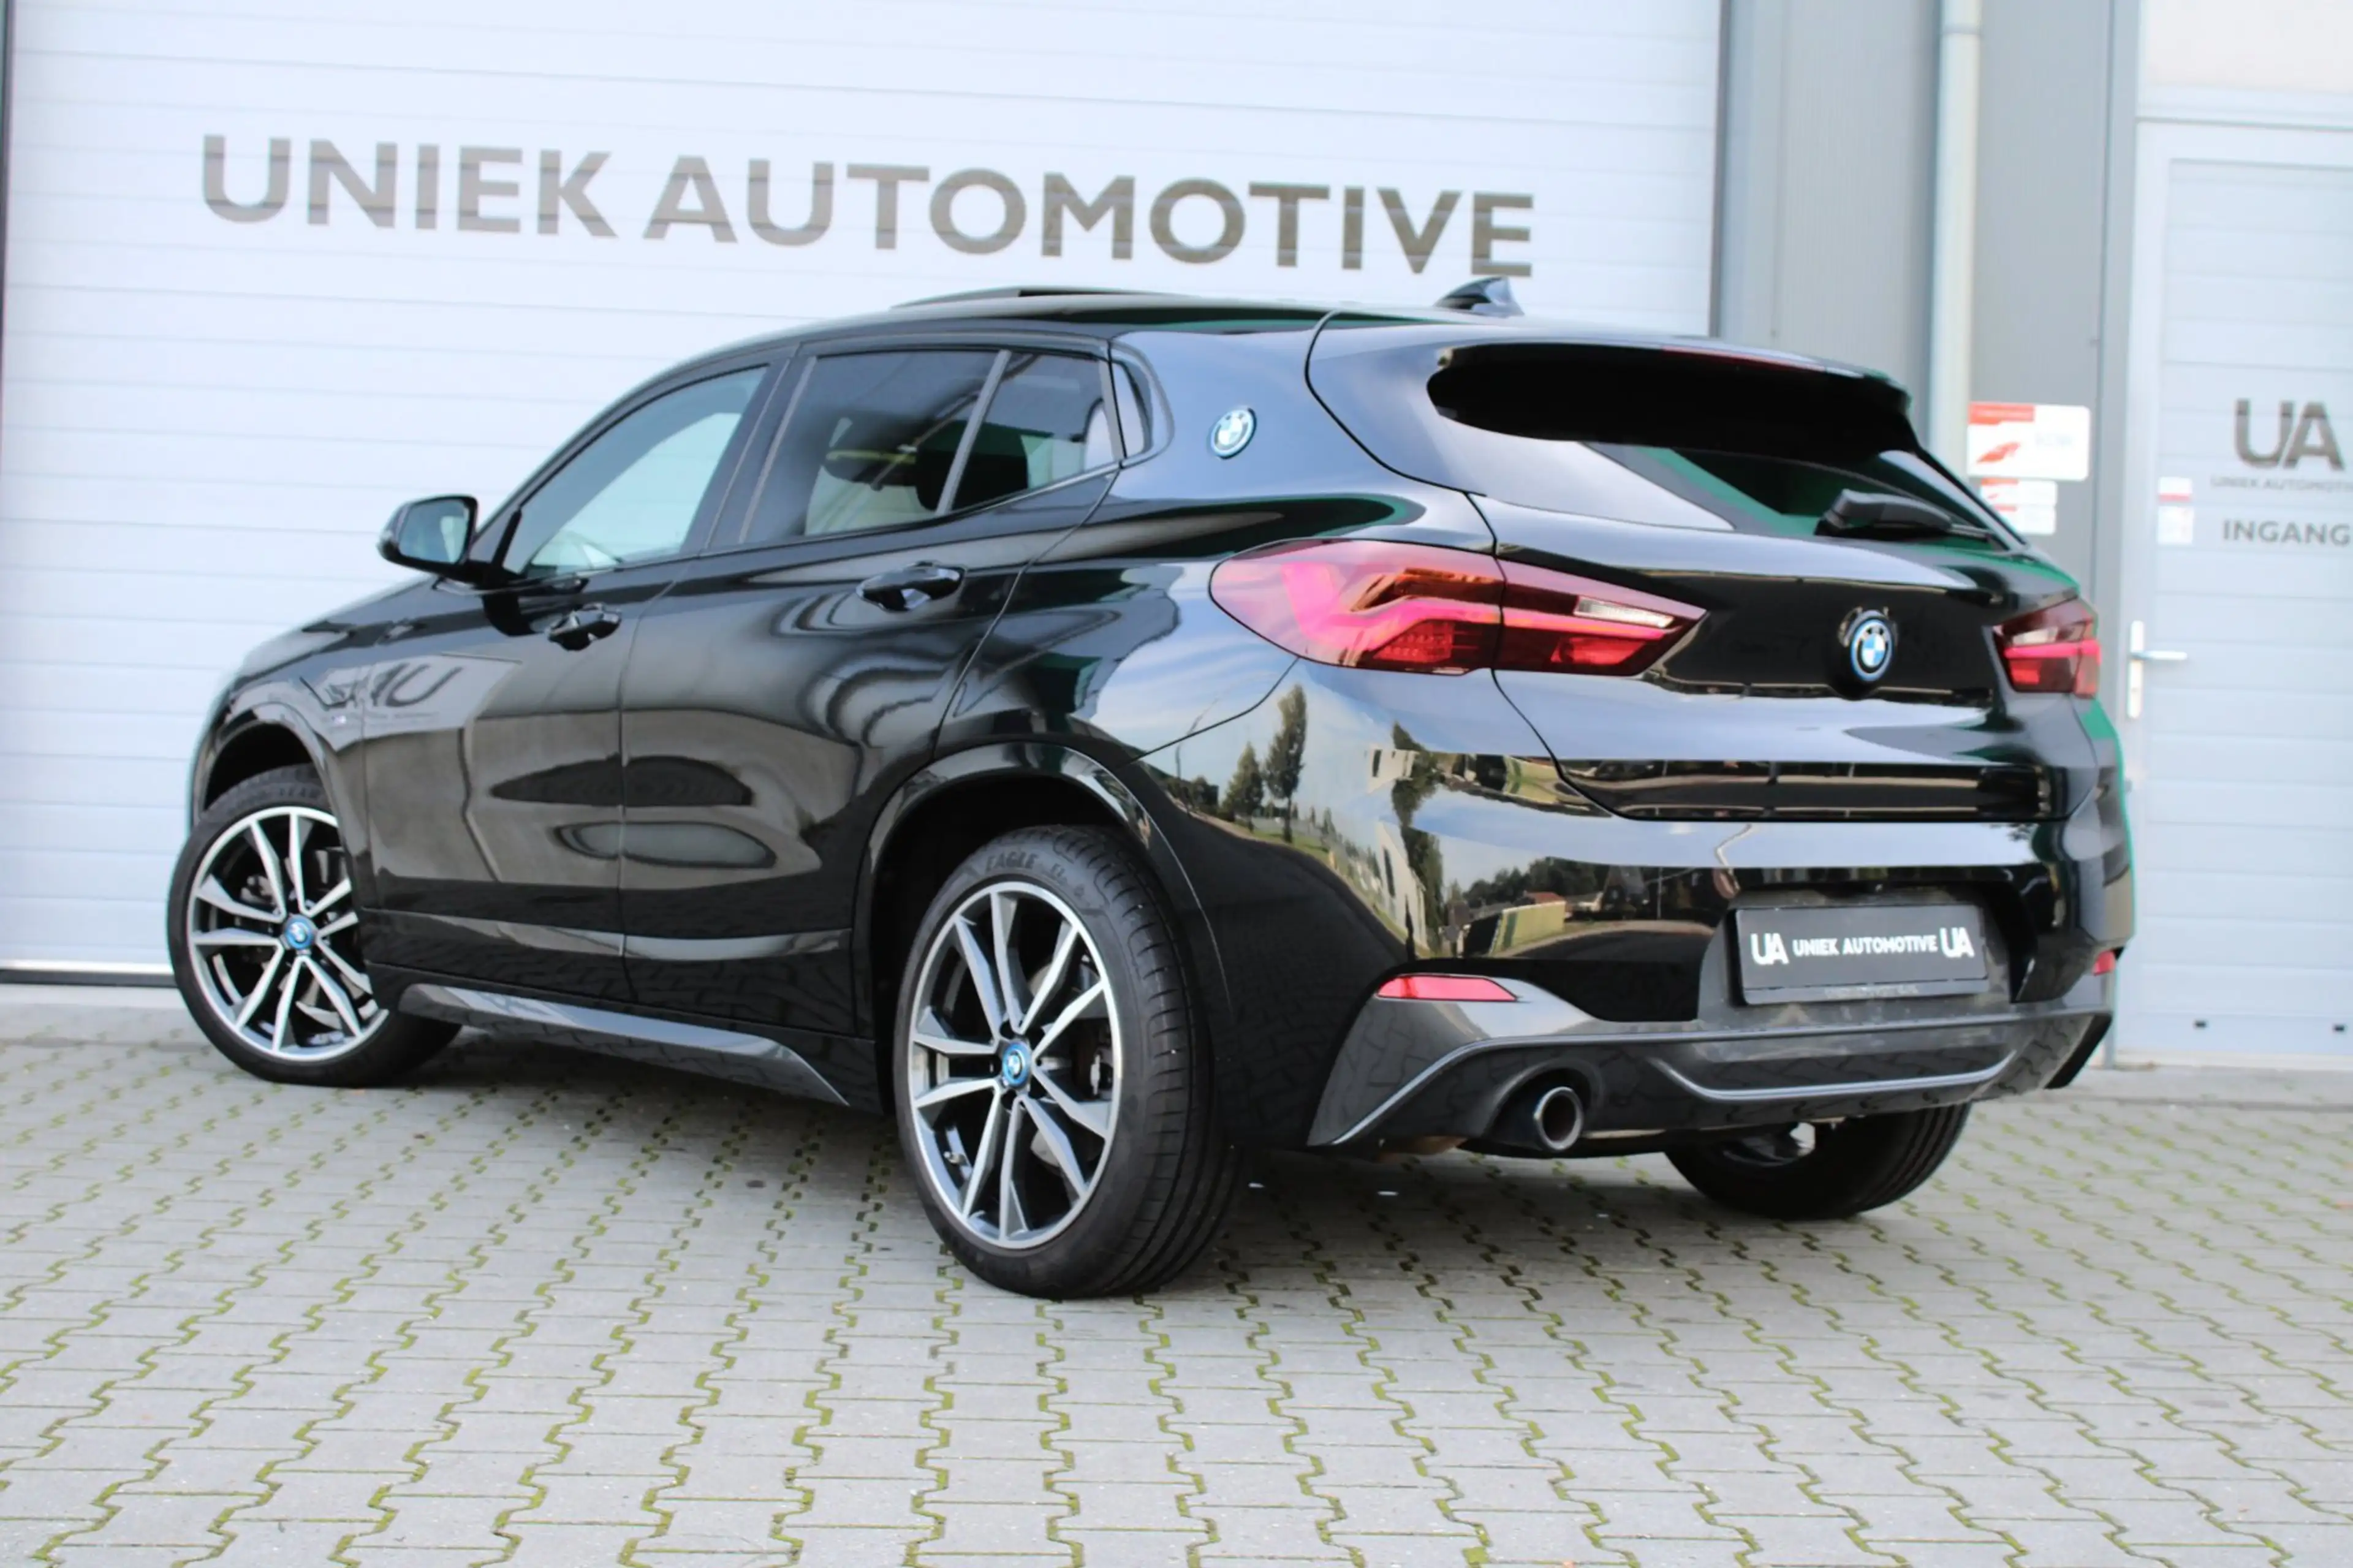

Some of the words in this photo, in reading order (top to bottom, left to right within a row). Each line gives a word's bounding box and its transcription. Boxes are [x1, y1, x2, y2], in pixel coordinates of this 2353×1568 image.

[203, 134, 618, 238] UNIEK
[642, 154, 1534, 278] AUTOMOTIVE
[2235, 398, 2344, 471] UA
[2224, 519, 2351, 547] INGANG
[1750, 933, 1789, 965] UA
[1792, 939, 1840, 957] UNIEK
[1842, 934, 1938, 955] AUTOMOTIVE
[1939, 926, 1975, 958] UA
